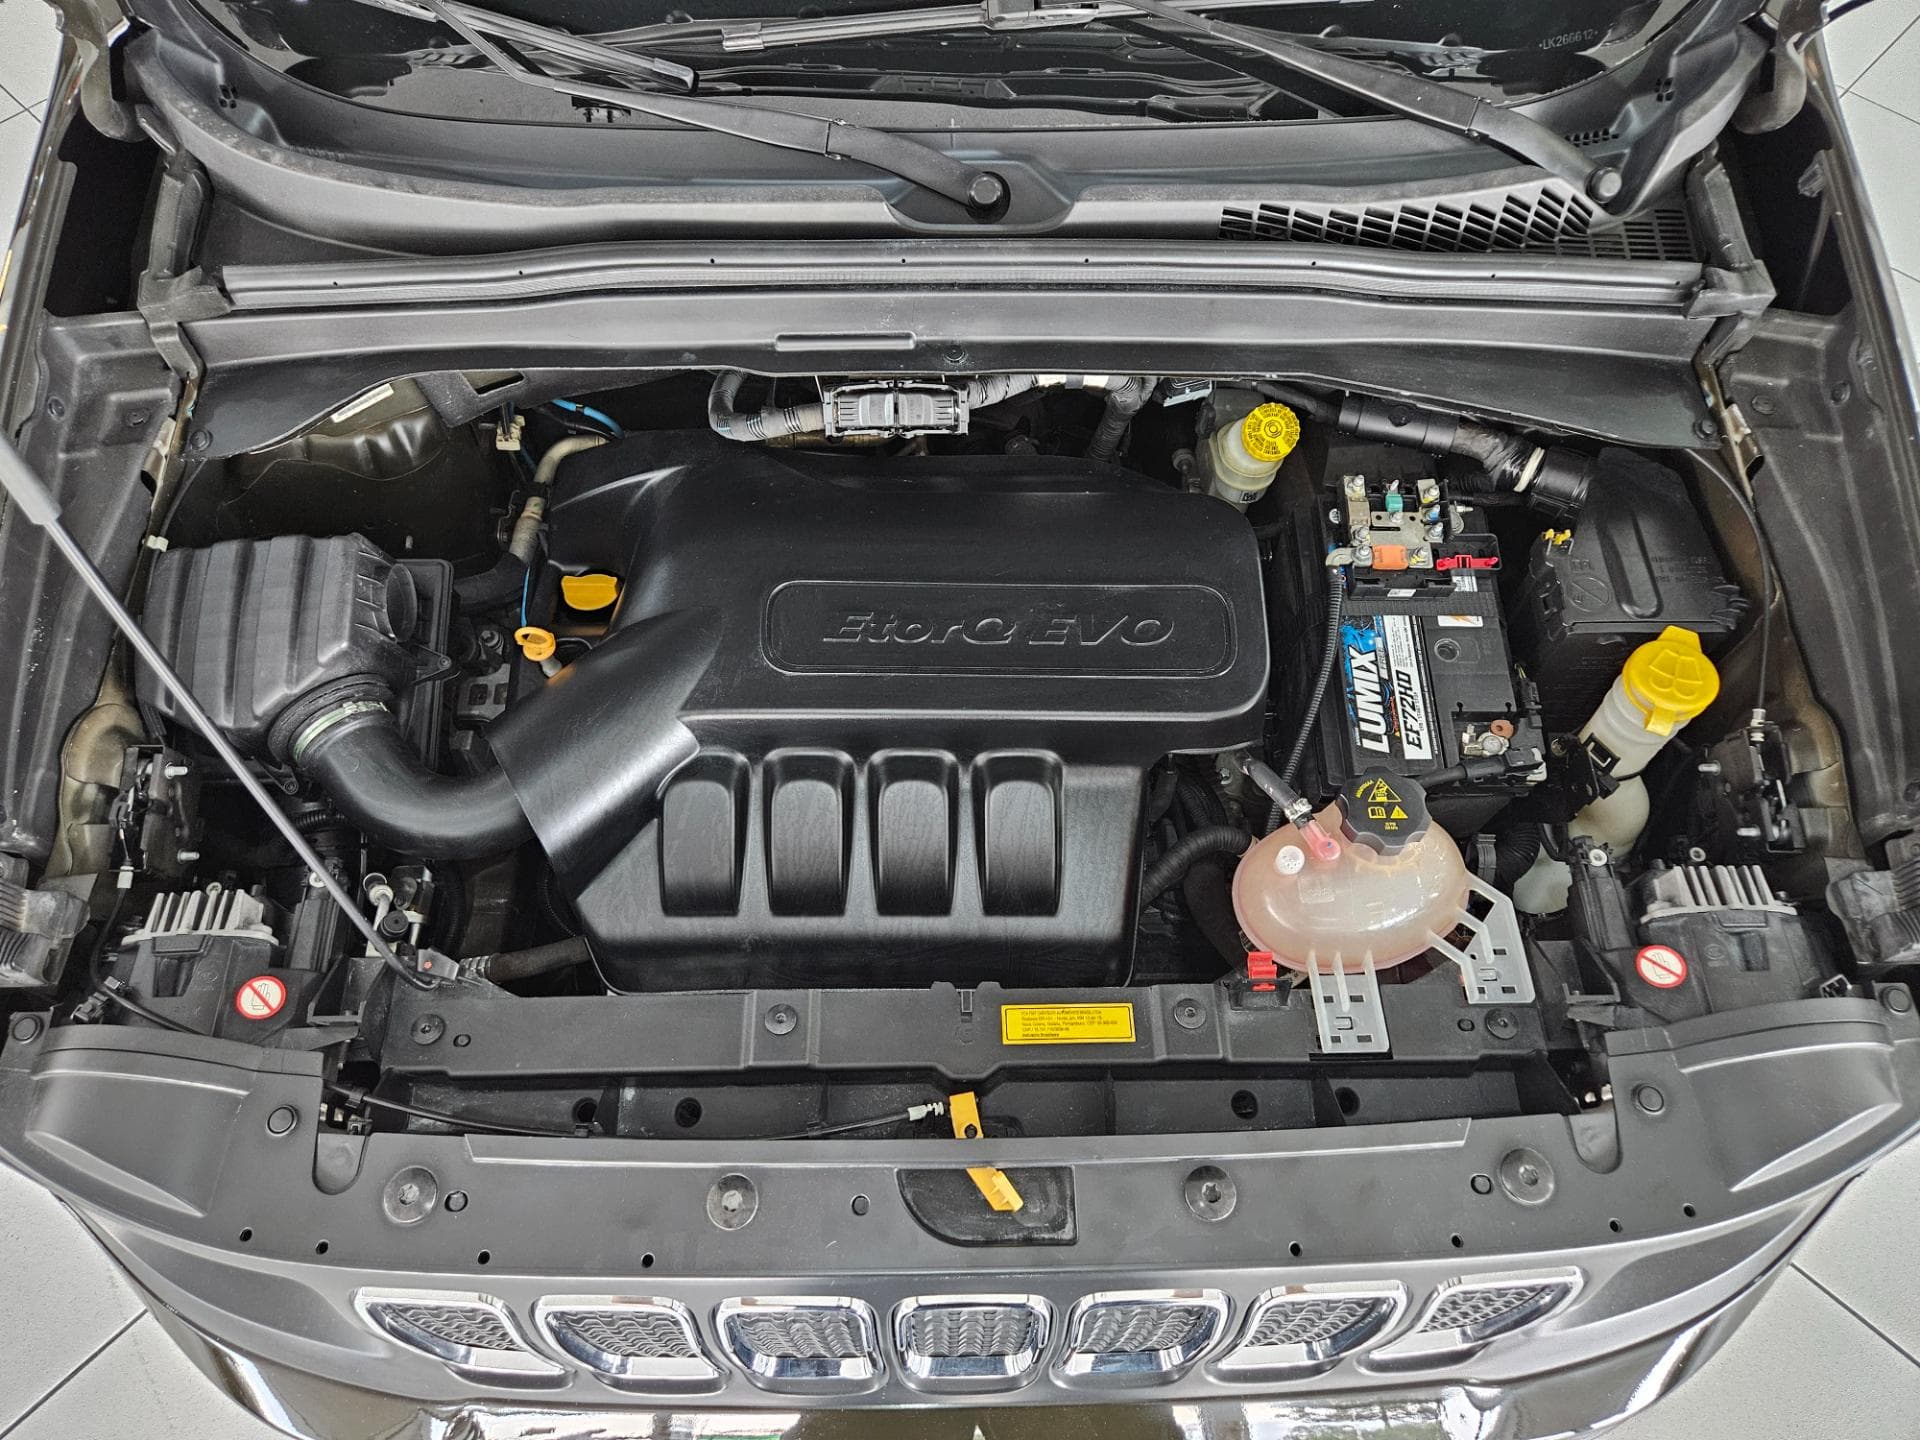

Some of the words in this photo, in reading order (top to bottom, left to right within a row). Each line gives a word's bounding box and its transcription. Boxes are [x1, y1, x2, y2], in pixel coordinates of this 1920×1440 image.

[822, 610, 1017, 645] EtorQ
[1028, 613, 1176, 647] EVO
[1348, 645, 1390, 754] LUMIX
